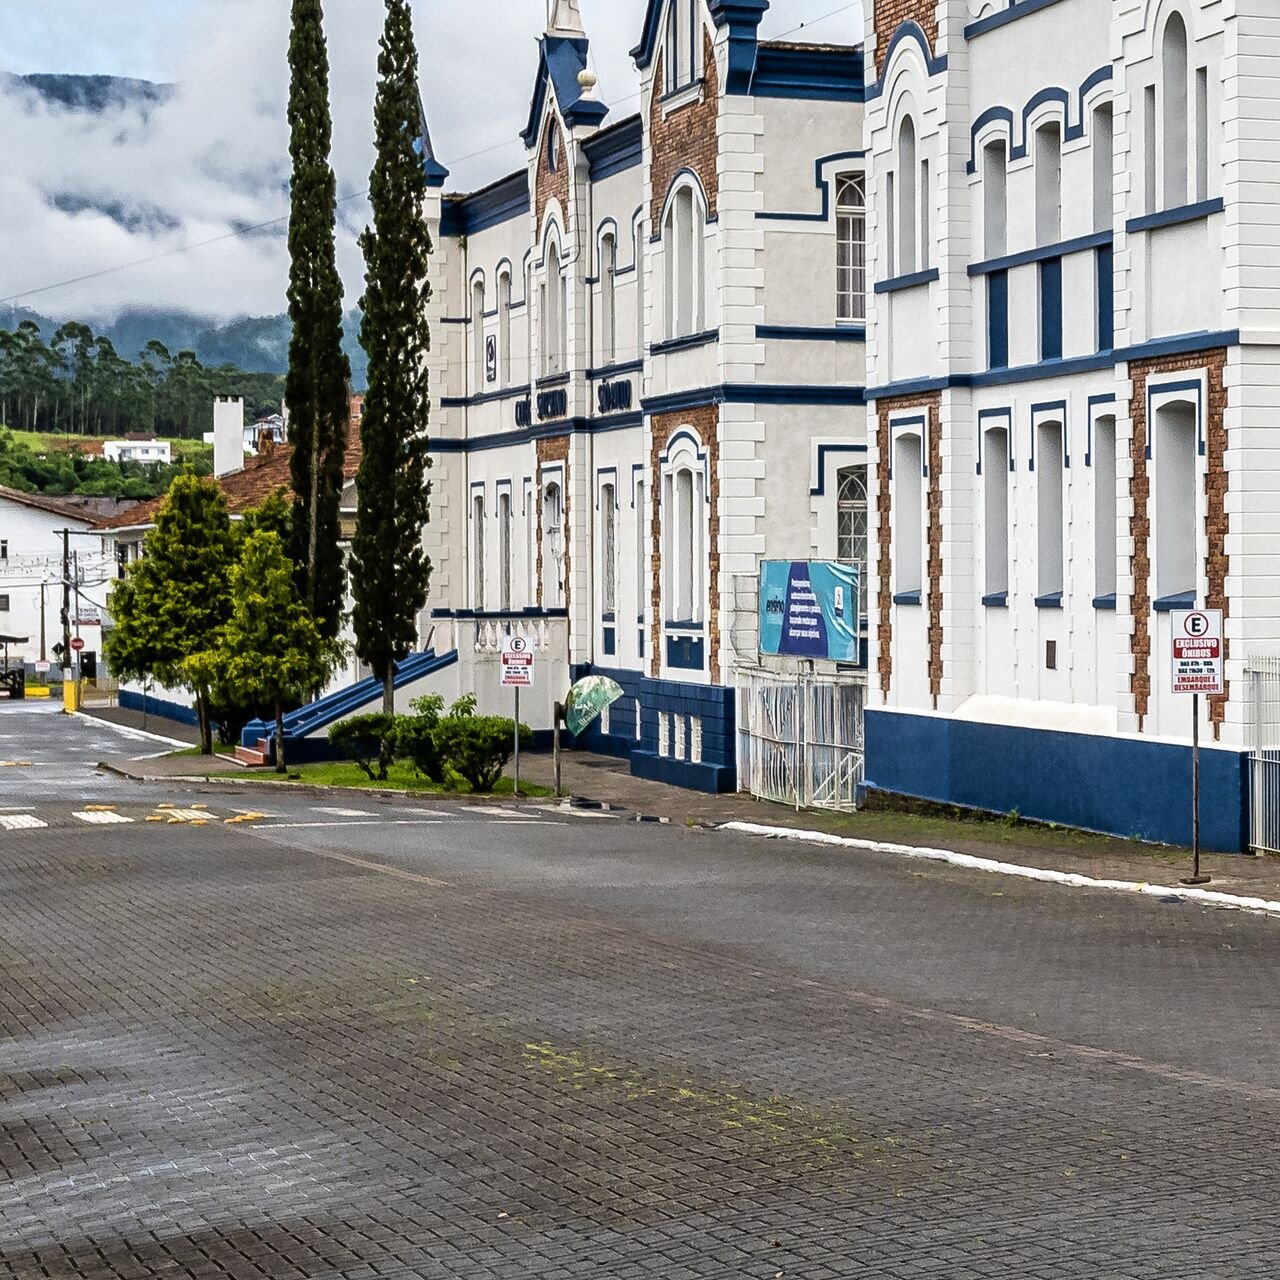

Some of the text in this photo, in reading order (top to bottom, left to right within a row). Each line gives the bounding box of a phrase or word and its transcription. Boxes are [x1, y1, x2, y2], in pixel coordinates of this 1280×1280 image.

[1191, 617, 1201, 633] E
[514, 640, 521, 650] E
[1175, 639, 1217, 649] EXCLUSIVO
[1181, 648, 1212, 658] ÔNIBUS
[1177, 676, 1211, 684] EMBARQUE
[1174, 683, 1219, 692] DESEMBARQUE
